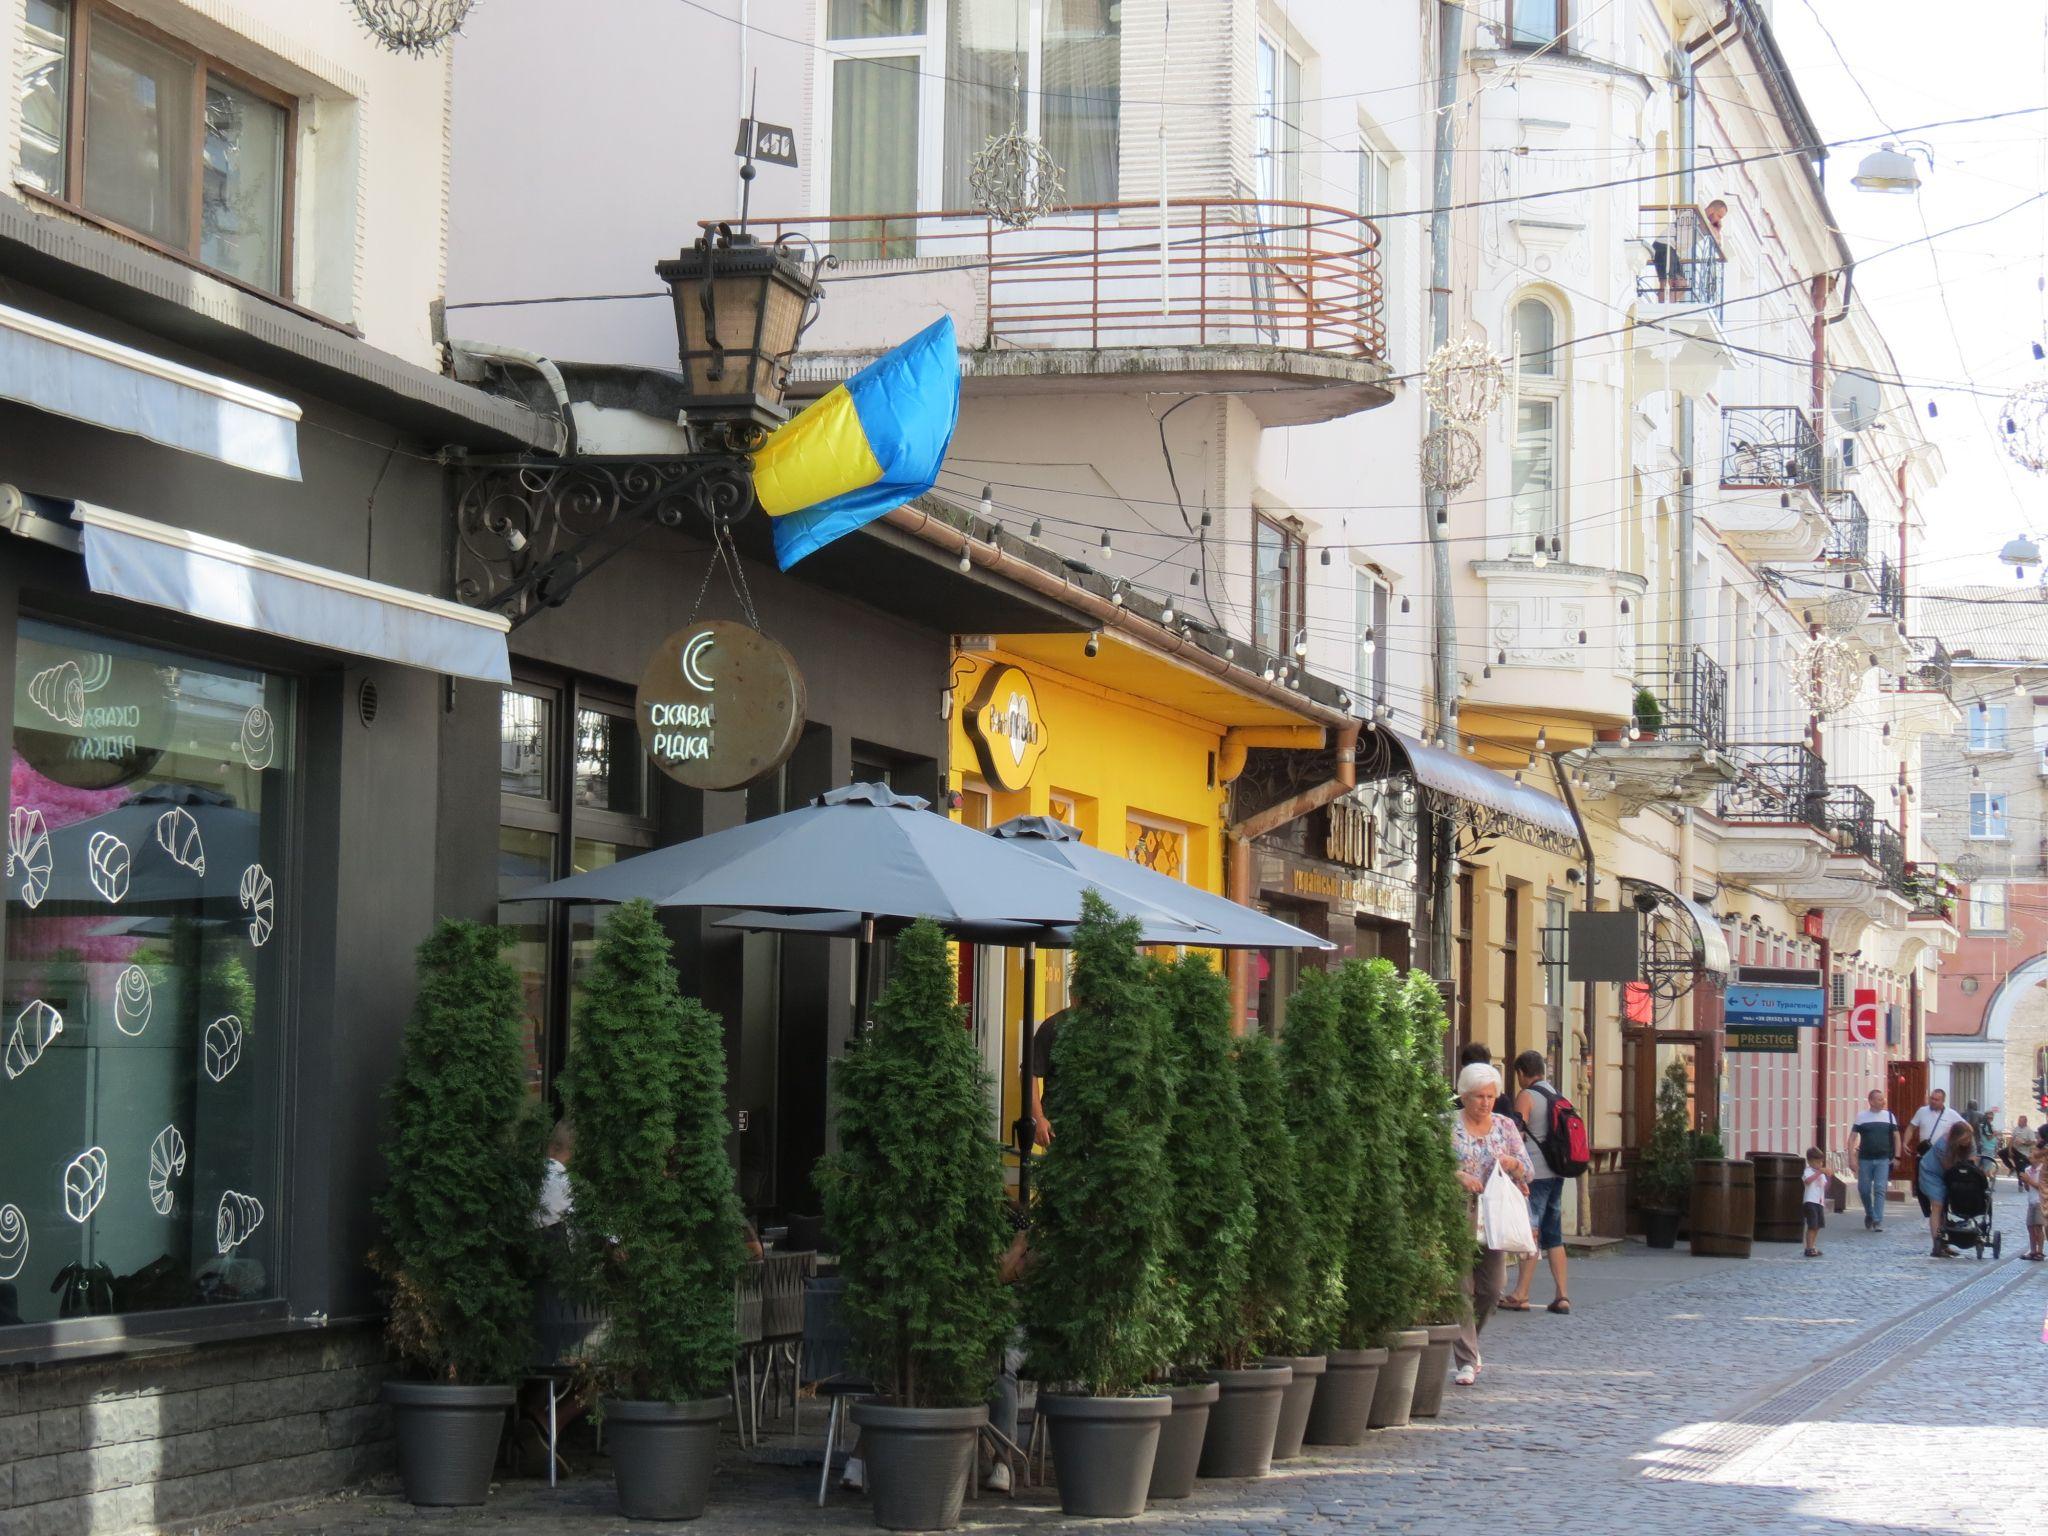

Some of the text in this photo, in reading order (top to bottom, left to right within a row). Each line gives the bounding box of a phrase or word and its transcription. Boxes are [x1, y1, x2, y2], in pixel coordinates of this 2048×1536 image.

[651, 704, 711, 728] СКАВА
[654, 733, 709, 760] РІДКА
[1761, 1000, 1818, 1010] TUI Турагенція
[1741, 1033, 1794, 1045] PRESTIGE
